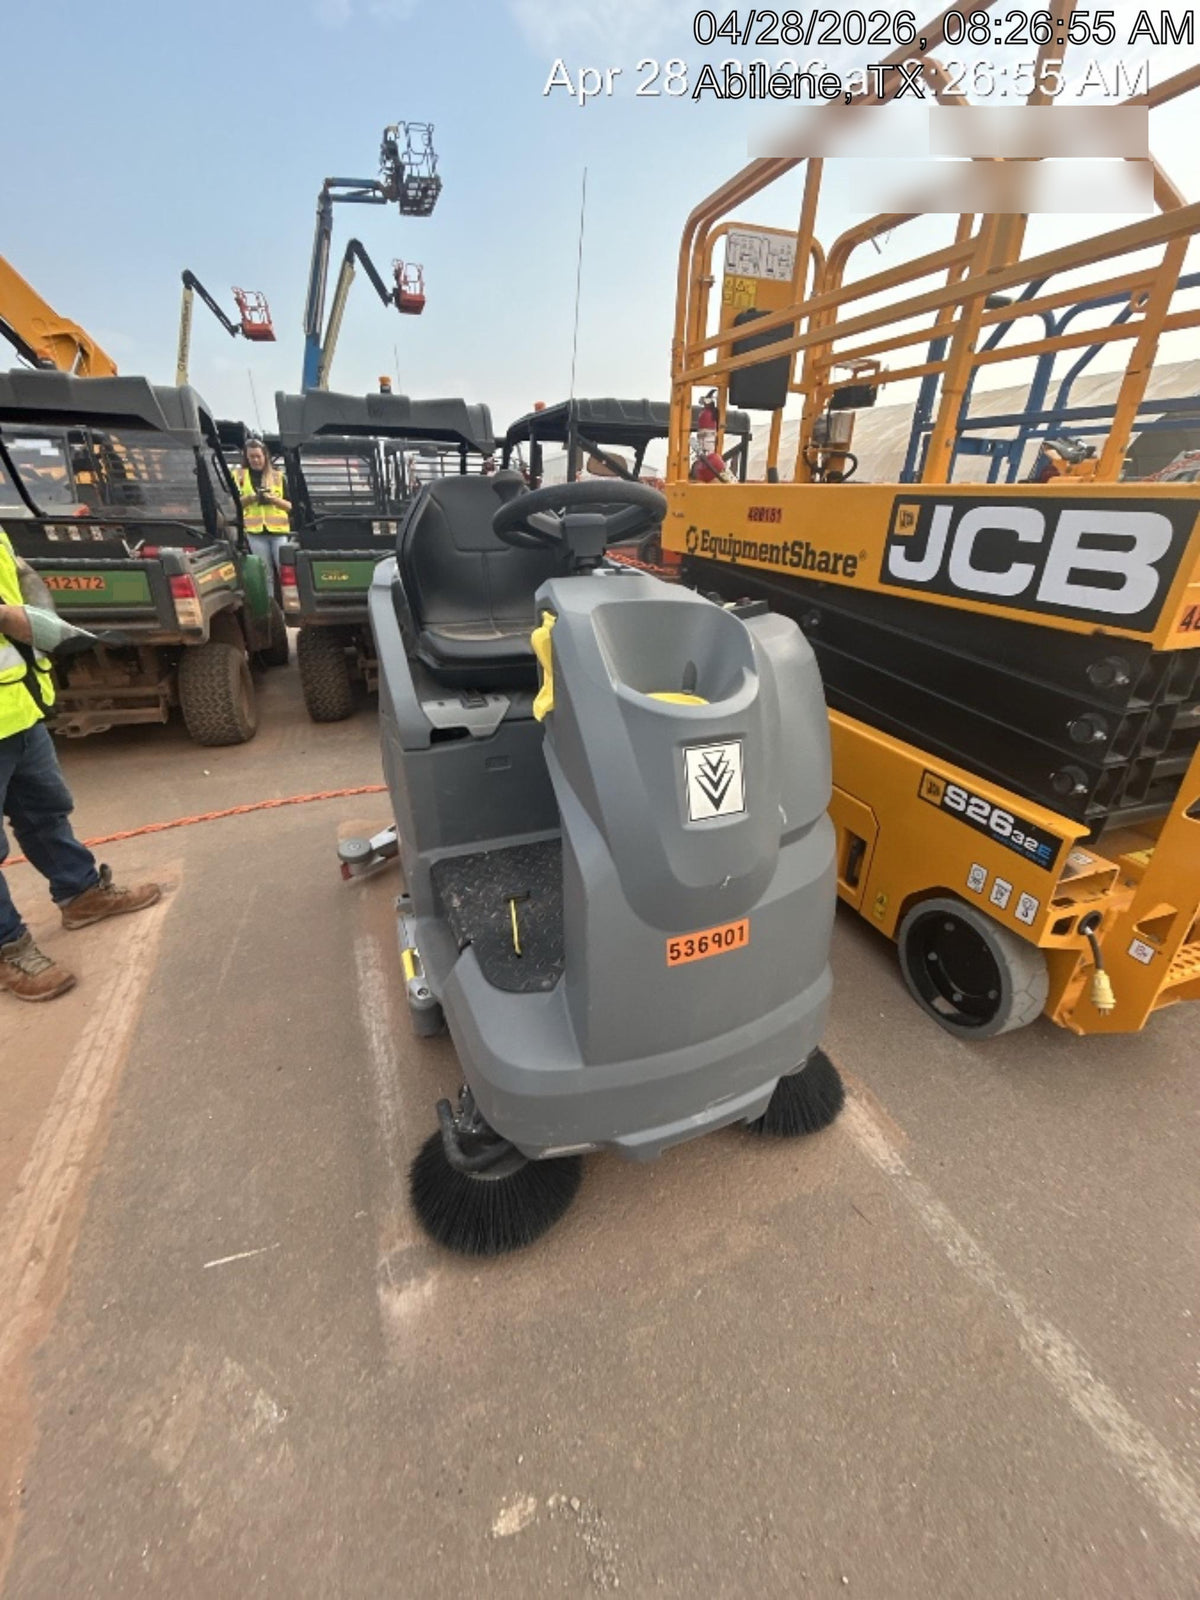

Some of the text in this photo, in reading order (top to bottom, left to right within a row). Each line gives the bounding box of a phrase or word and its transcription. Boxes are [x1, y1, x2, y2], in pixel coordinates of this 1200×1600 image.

[700, 529, 858, 578] EquipmentShare
[888, 505, 1173, 615] JCB
[669, 925, 744, 961] 536901
